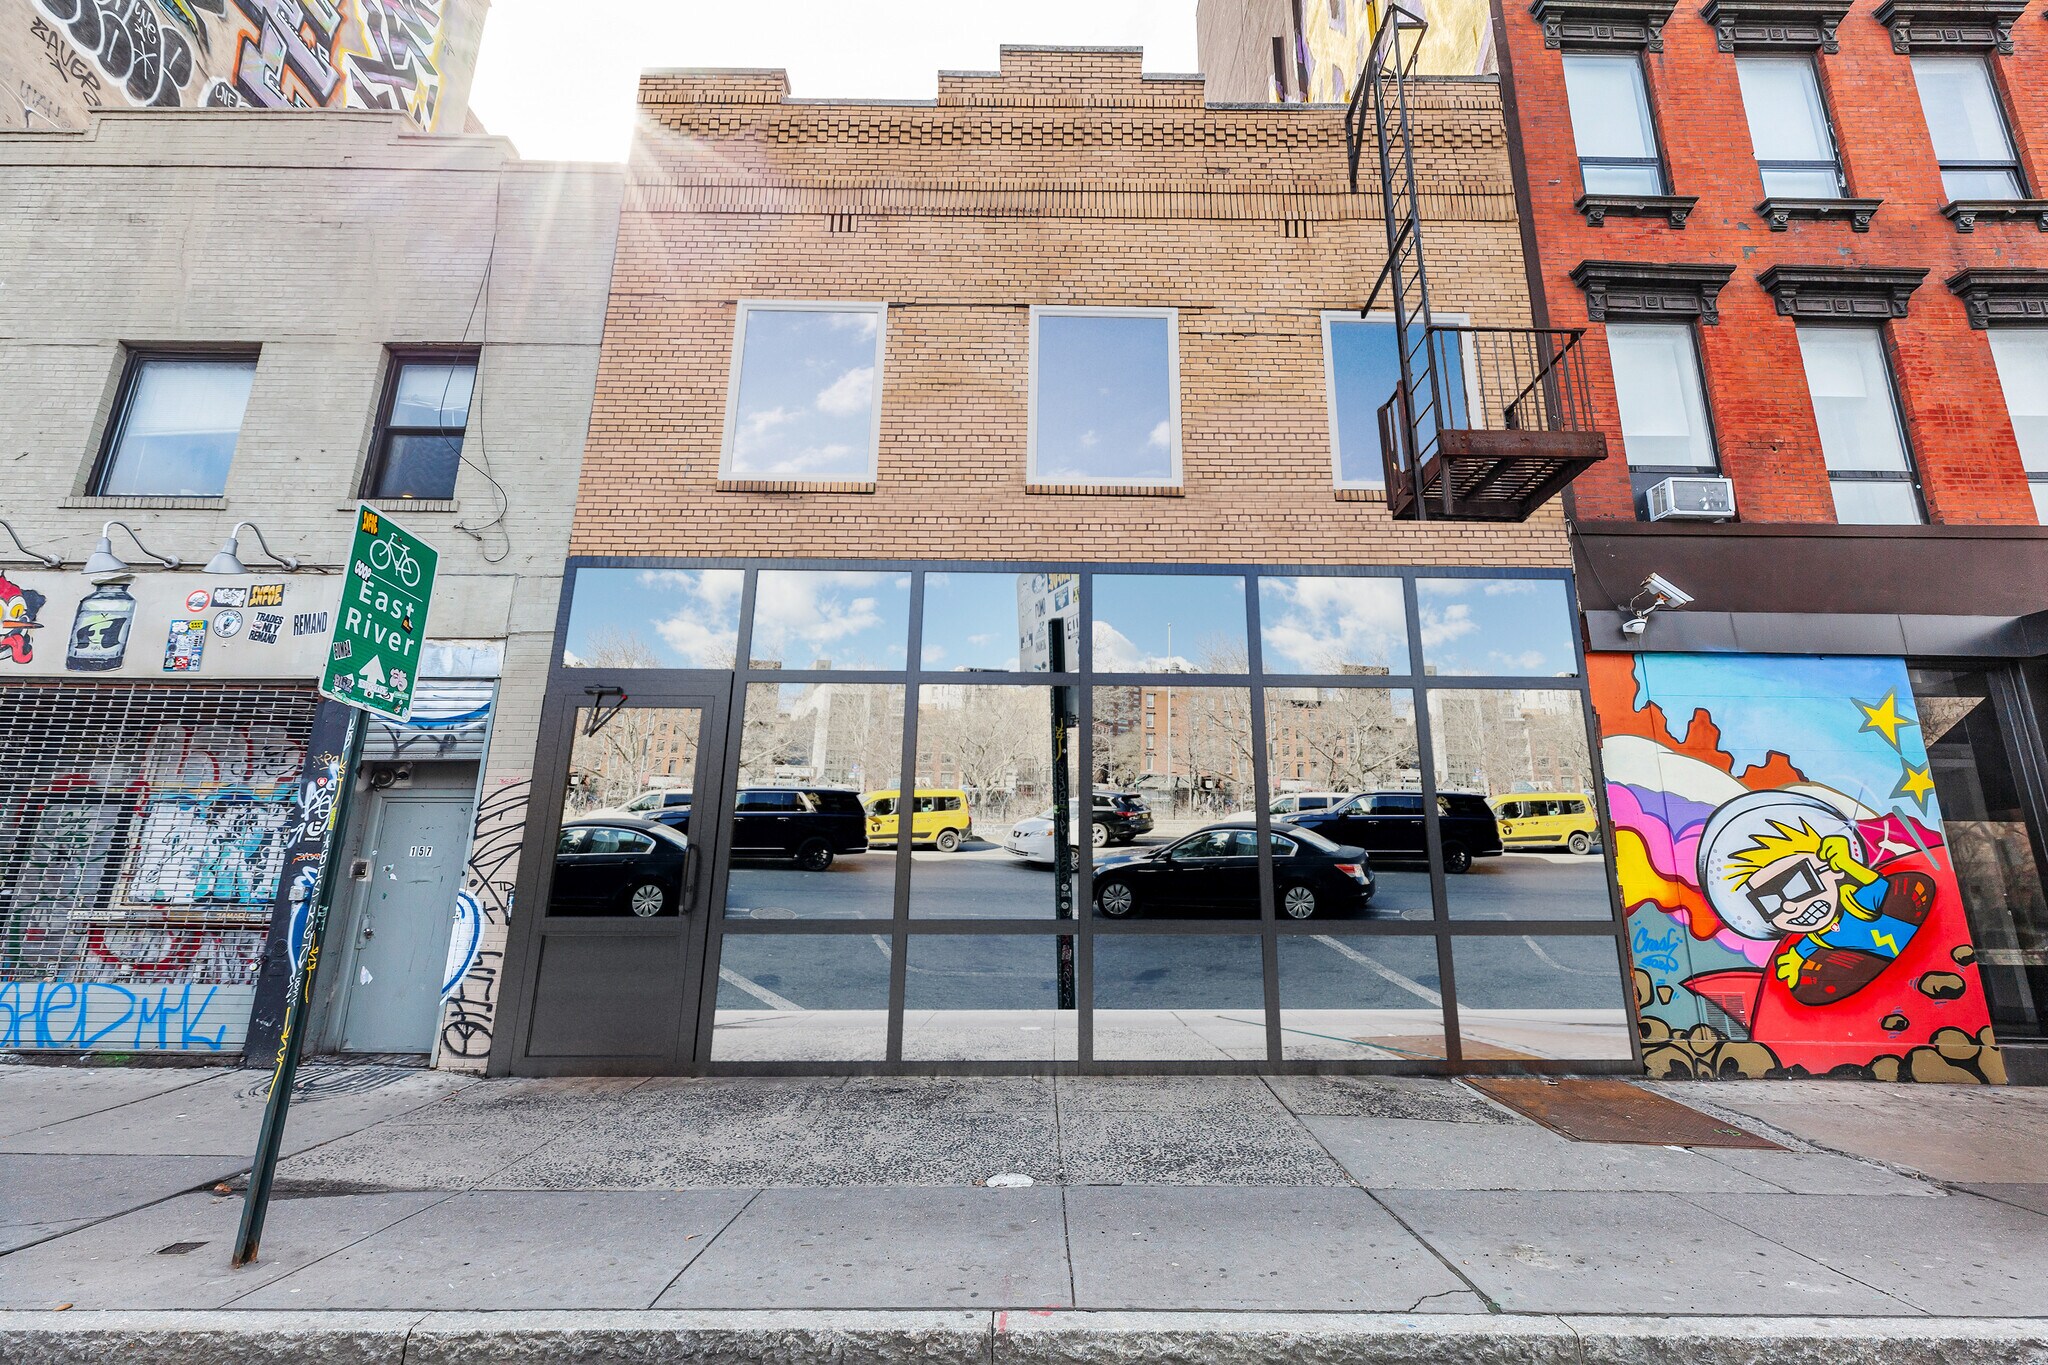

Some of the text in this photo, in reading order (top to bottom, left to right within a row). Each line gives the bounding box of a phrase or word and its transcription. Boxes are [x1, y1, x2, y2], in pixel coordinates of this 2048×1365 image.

[358, 580, 415, 621] East
[255, 611, 284, 625] TRADES
[293, 611, 328, 636] REMAND
[248, 630, 278, 644] REMAND
[345, 607, 415, 656] River
[410, 845, 433, 857] 157
